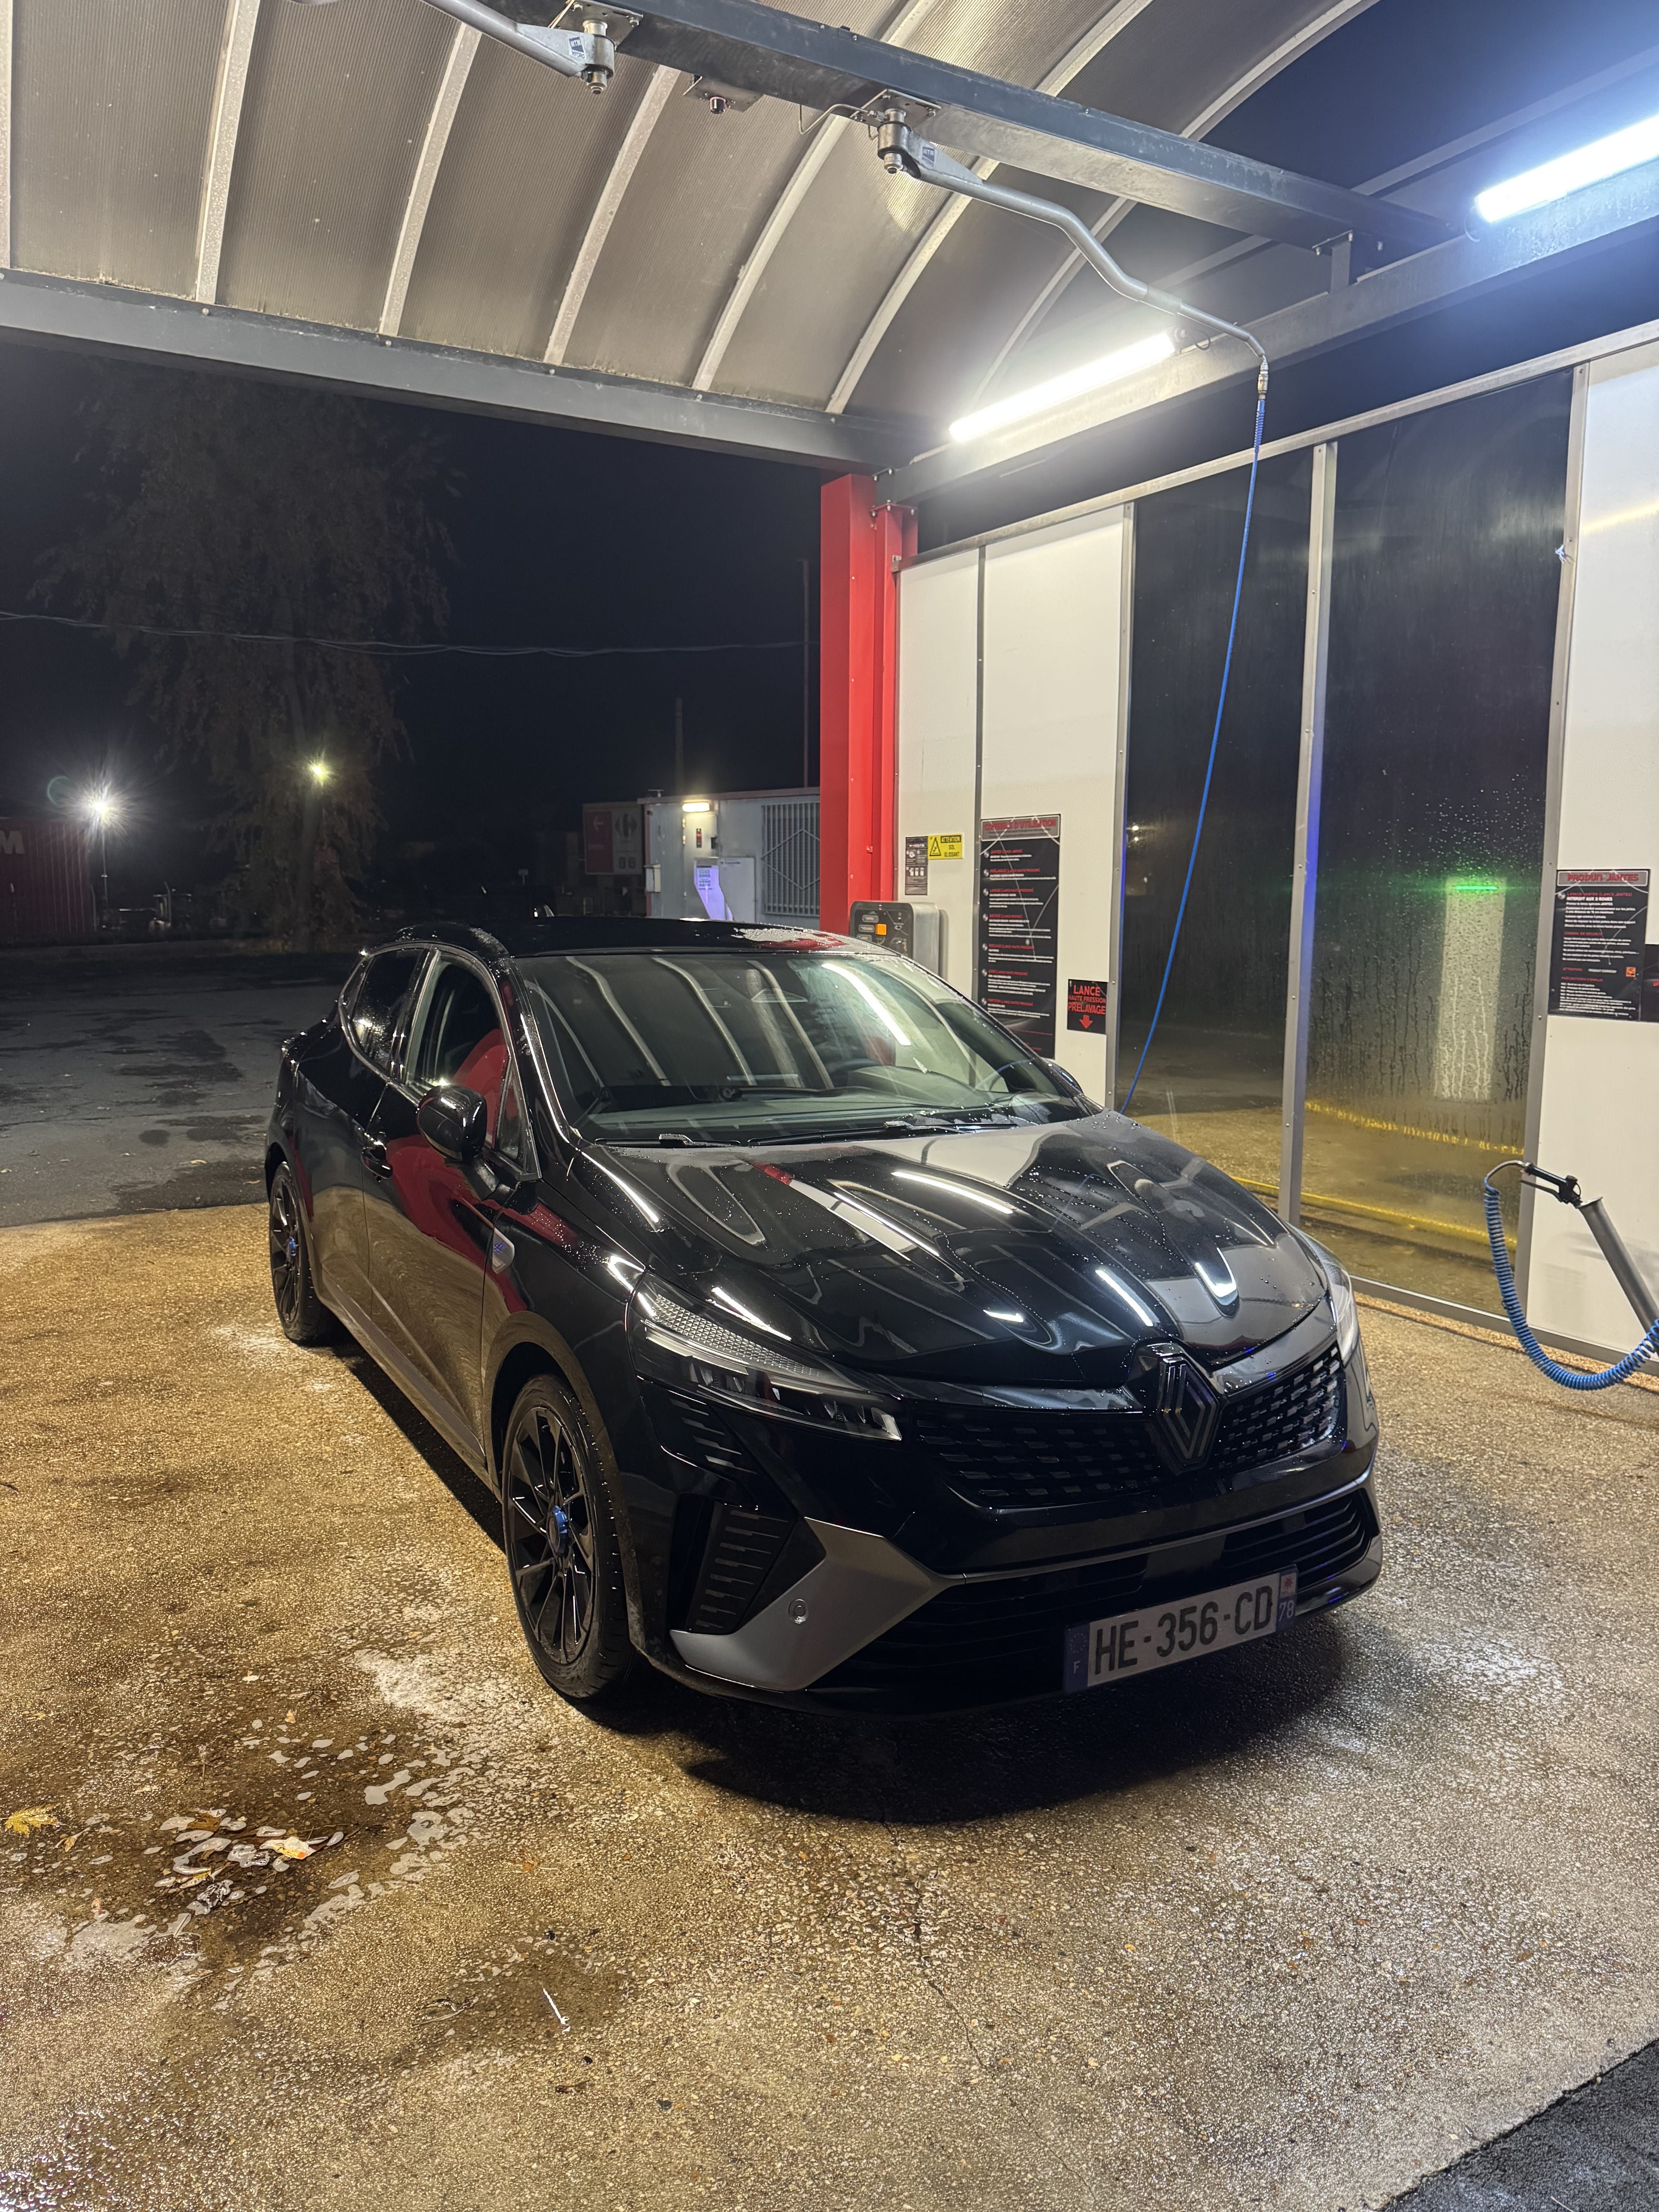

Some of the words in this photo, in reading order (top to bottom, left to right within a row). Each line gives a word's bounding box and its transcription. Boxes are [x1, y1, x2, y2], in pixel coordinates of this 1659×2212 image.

[1073, 985, 1100, 996] LANCE
[1073, 1661, 1080, 1674] F
[1095, 1586, 1273, 1675] HE-356-CD
[1279, 1600, 1294, 1622] 78
